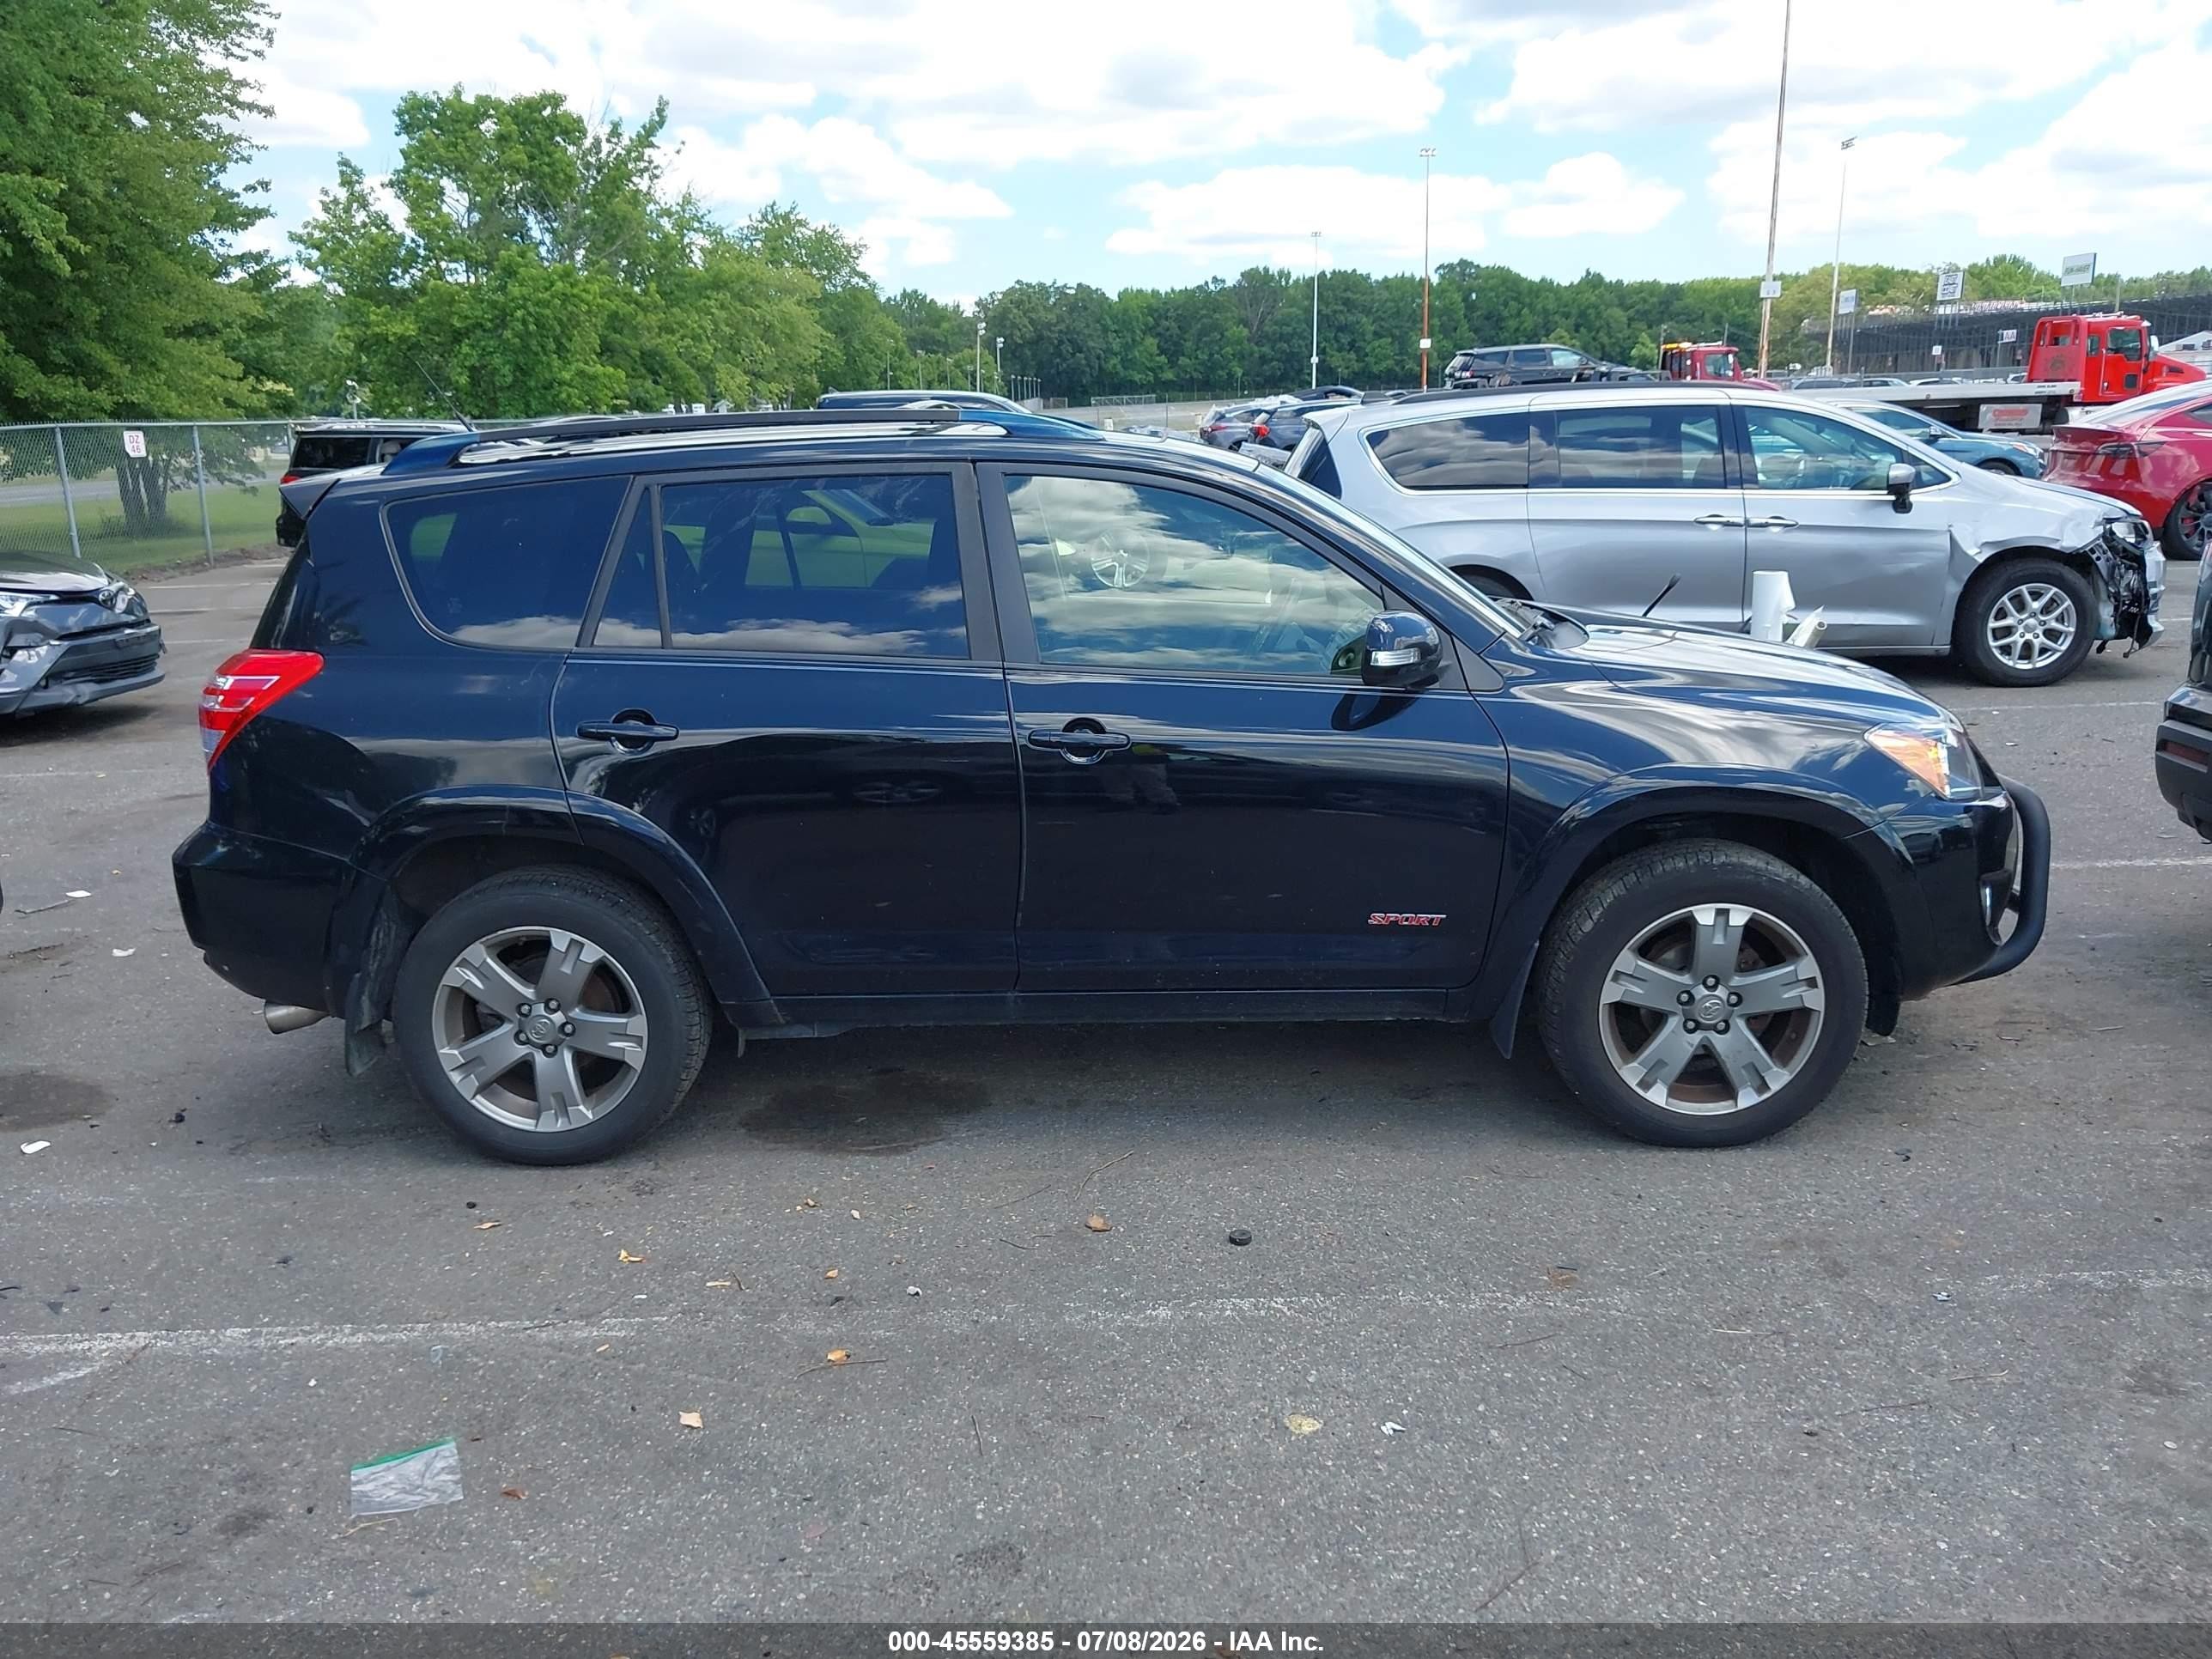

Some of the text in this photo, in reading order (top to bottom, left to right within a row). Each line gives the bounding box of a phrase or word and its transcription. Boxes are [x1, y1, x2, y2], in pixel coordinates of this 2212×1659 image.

[2004, 331, 2015, 340] AA
[129, 434, 141, 444] DZ
[131, 445, 142, 453] 46
[1368, 913, 1448, 927] SPORT
